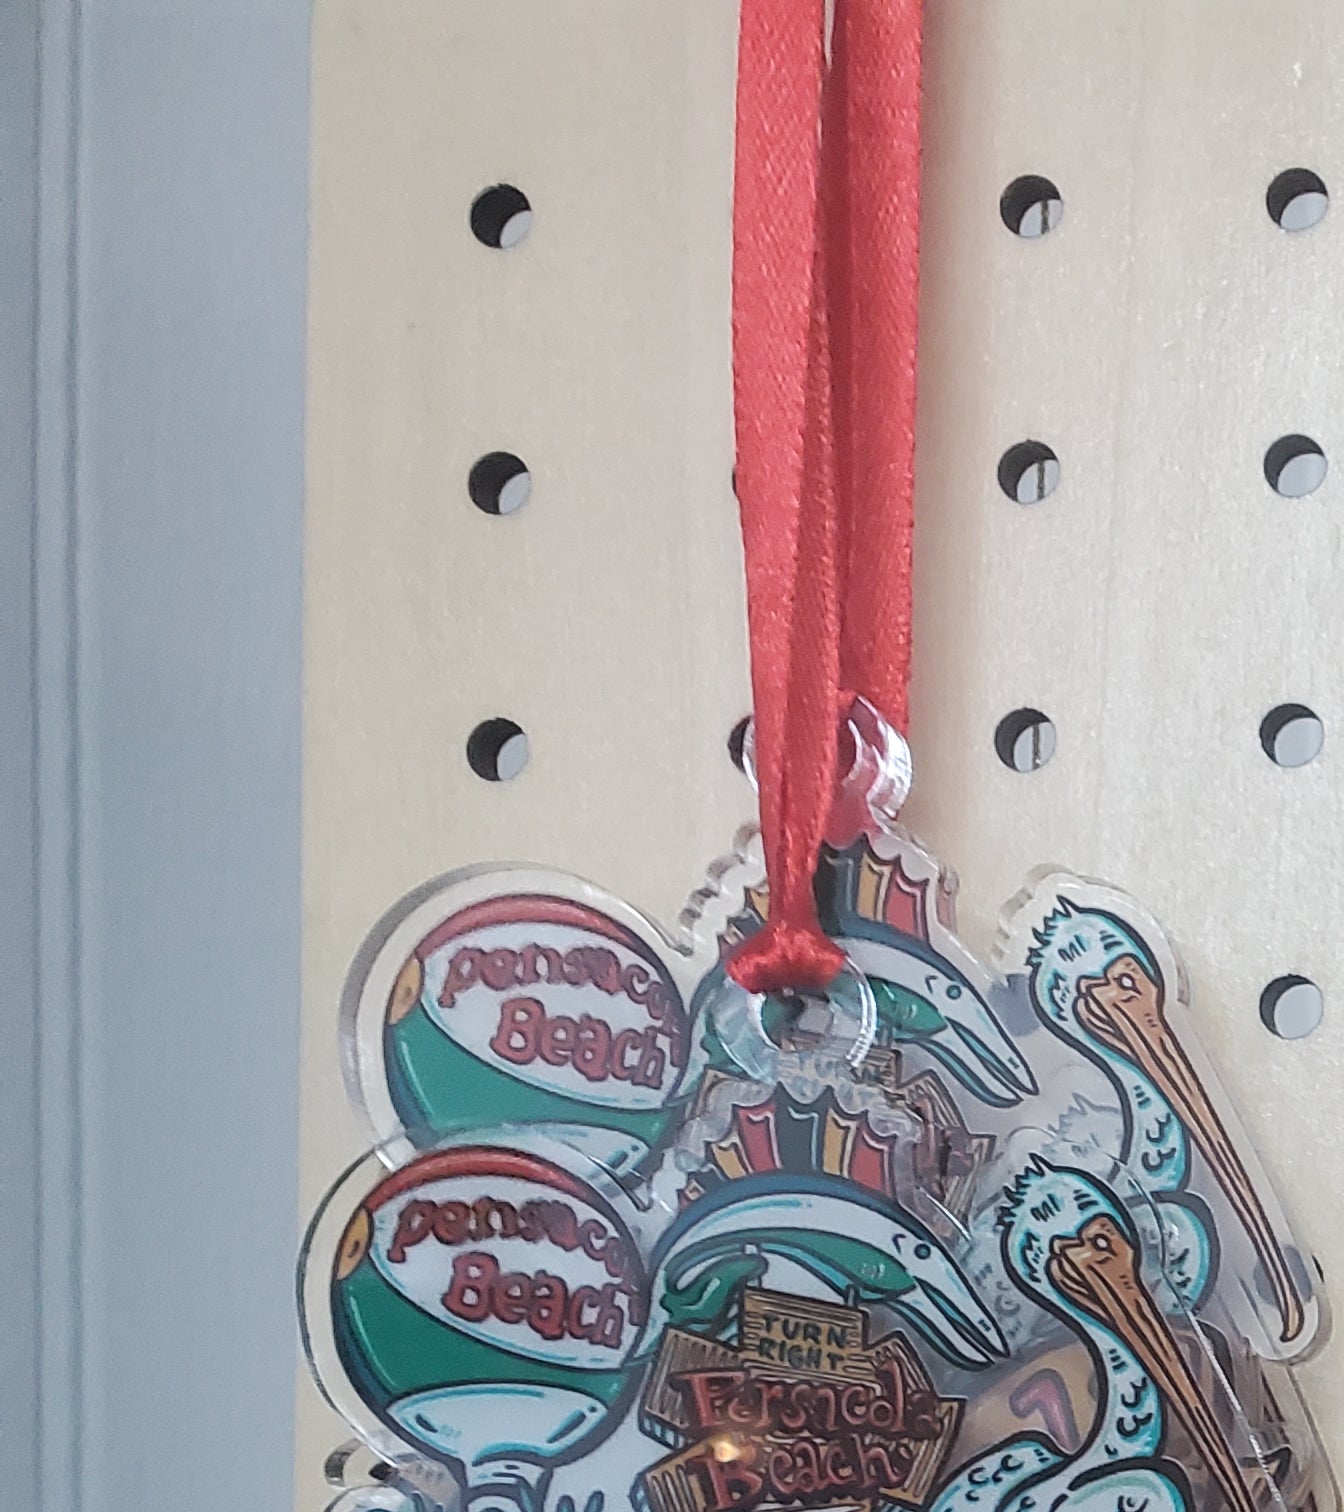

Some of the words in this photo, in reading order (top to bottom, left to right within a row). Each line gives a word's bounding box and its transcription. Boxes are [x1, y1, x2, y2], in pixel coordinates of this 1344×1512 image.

[490, 997, 662, 1090] Beach
[441, 1251, 624, 1349] Beach
[761, 1313, 850, 1347] TURN
[757, 1336, 846, 1370] RIGHT
